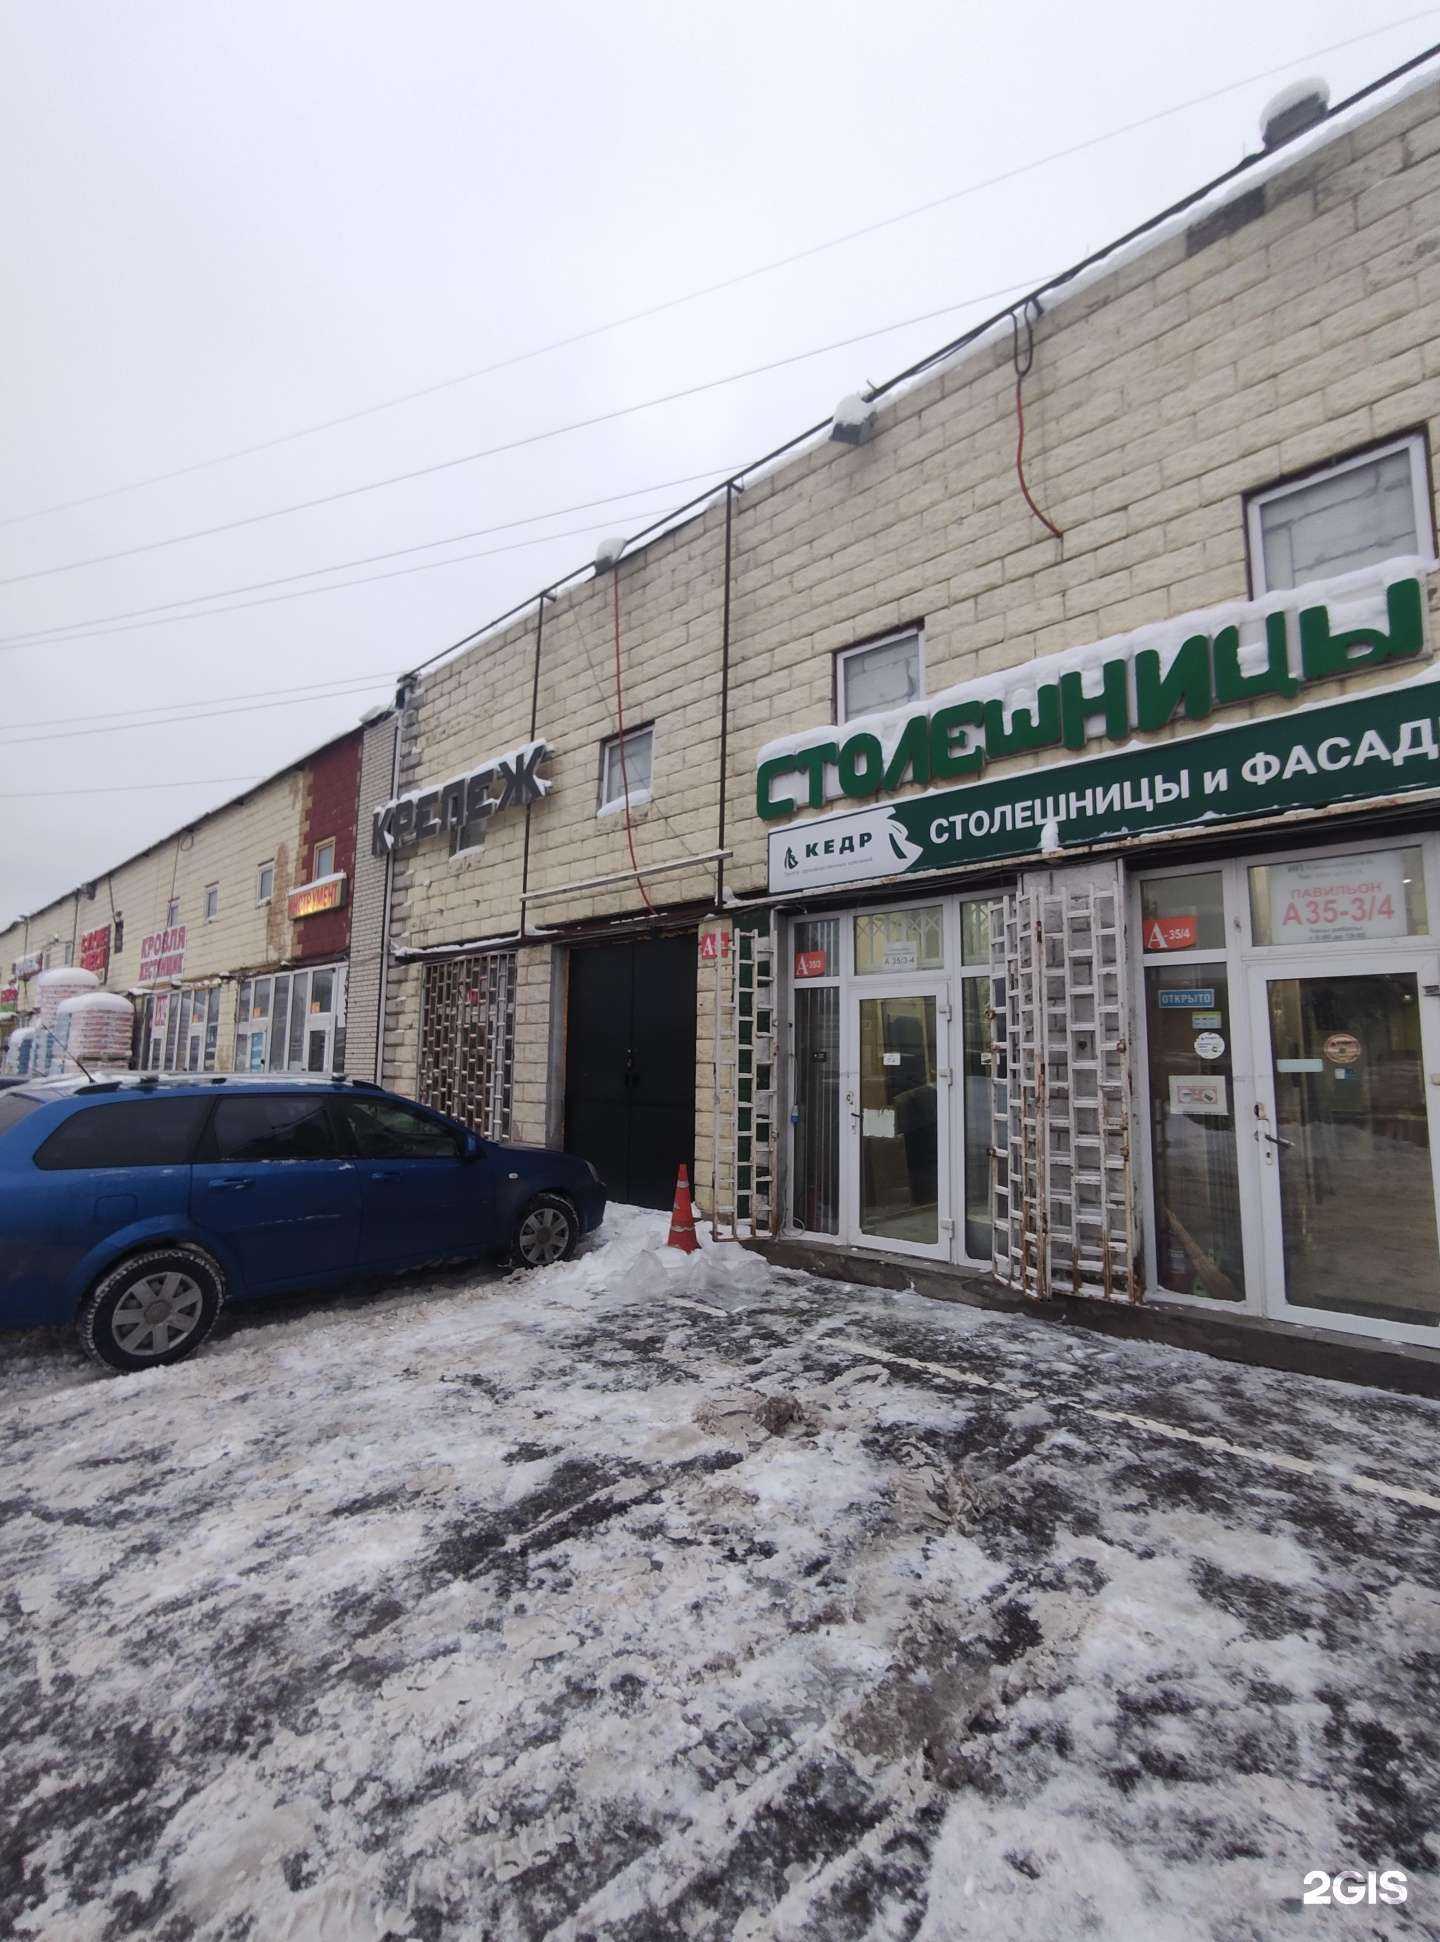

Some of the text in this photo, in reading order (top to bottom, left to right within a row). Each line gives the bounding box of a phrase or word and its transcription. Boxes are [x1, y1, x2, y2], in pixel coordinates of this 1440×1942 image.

[757, 576, 1424, 821] СТОЛЕШНИЦЫ
[929, 715, 1440, 845] СТОЛЕШНИЦЫ и ФАСАД
[372, 744, 552, 858] КРЕПЕЖ
[805, 832, 873, 858] КЕДР
[1291, 880, 1383, 899] ПАВИЛЬОН
[141, 926, 186, 959] КРОВЛЯ
[1161, 993, 1211, 1004] ОТКРЫТО
